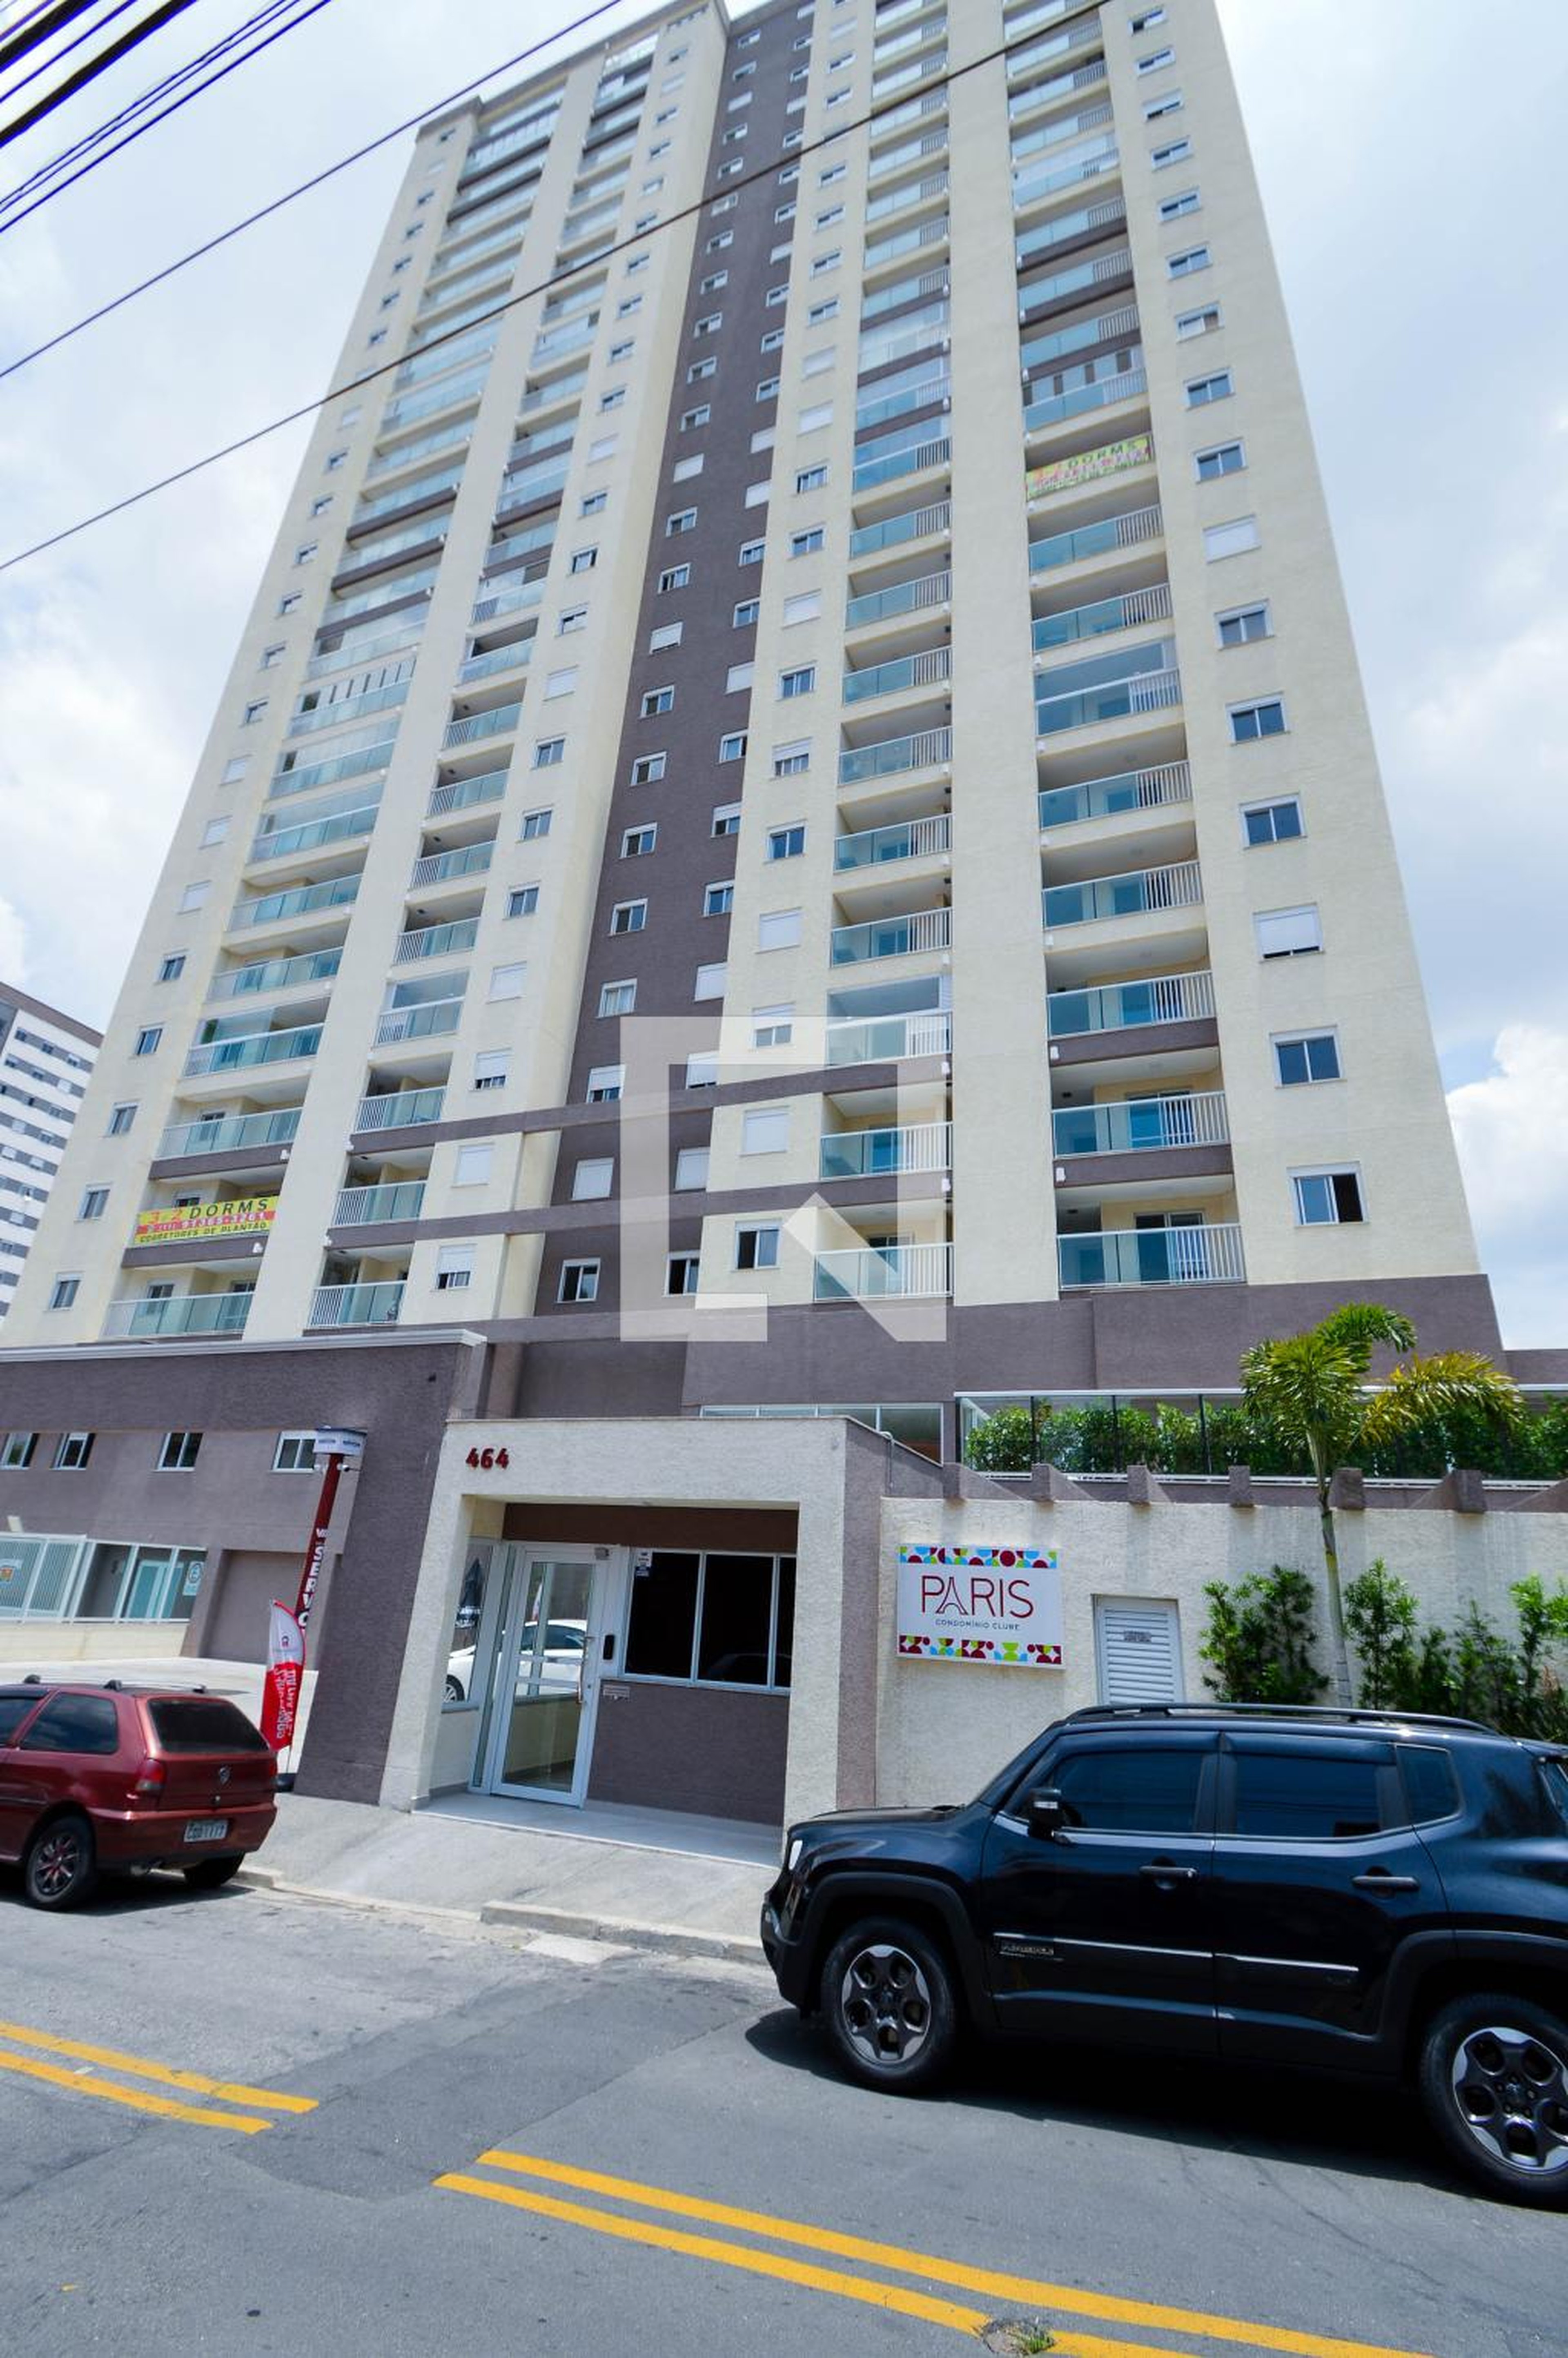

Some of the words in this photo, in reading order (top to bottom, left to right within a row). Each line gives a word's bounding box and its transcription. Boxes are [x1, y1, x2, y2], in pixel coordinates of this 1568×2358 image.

[189, 1198, 268, 1220] DORMS
[466, 1447, 509, 1469] 464
[921, 1575, 1034, 1619] PARIS
[992, 1623, 1021, 1631] CLUBE
